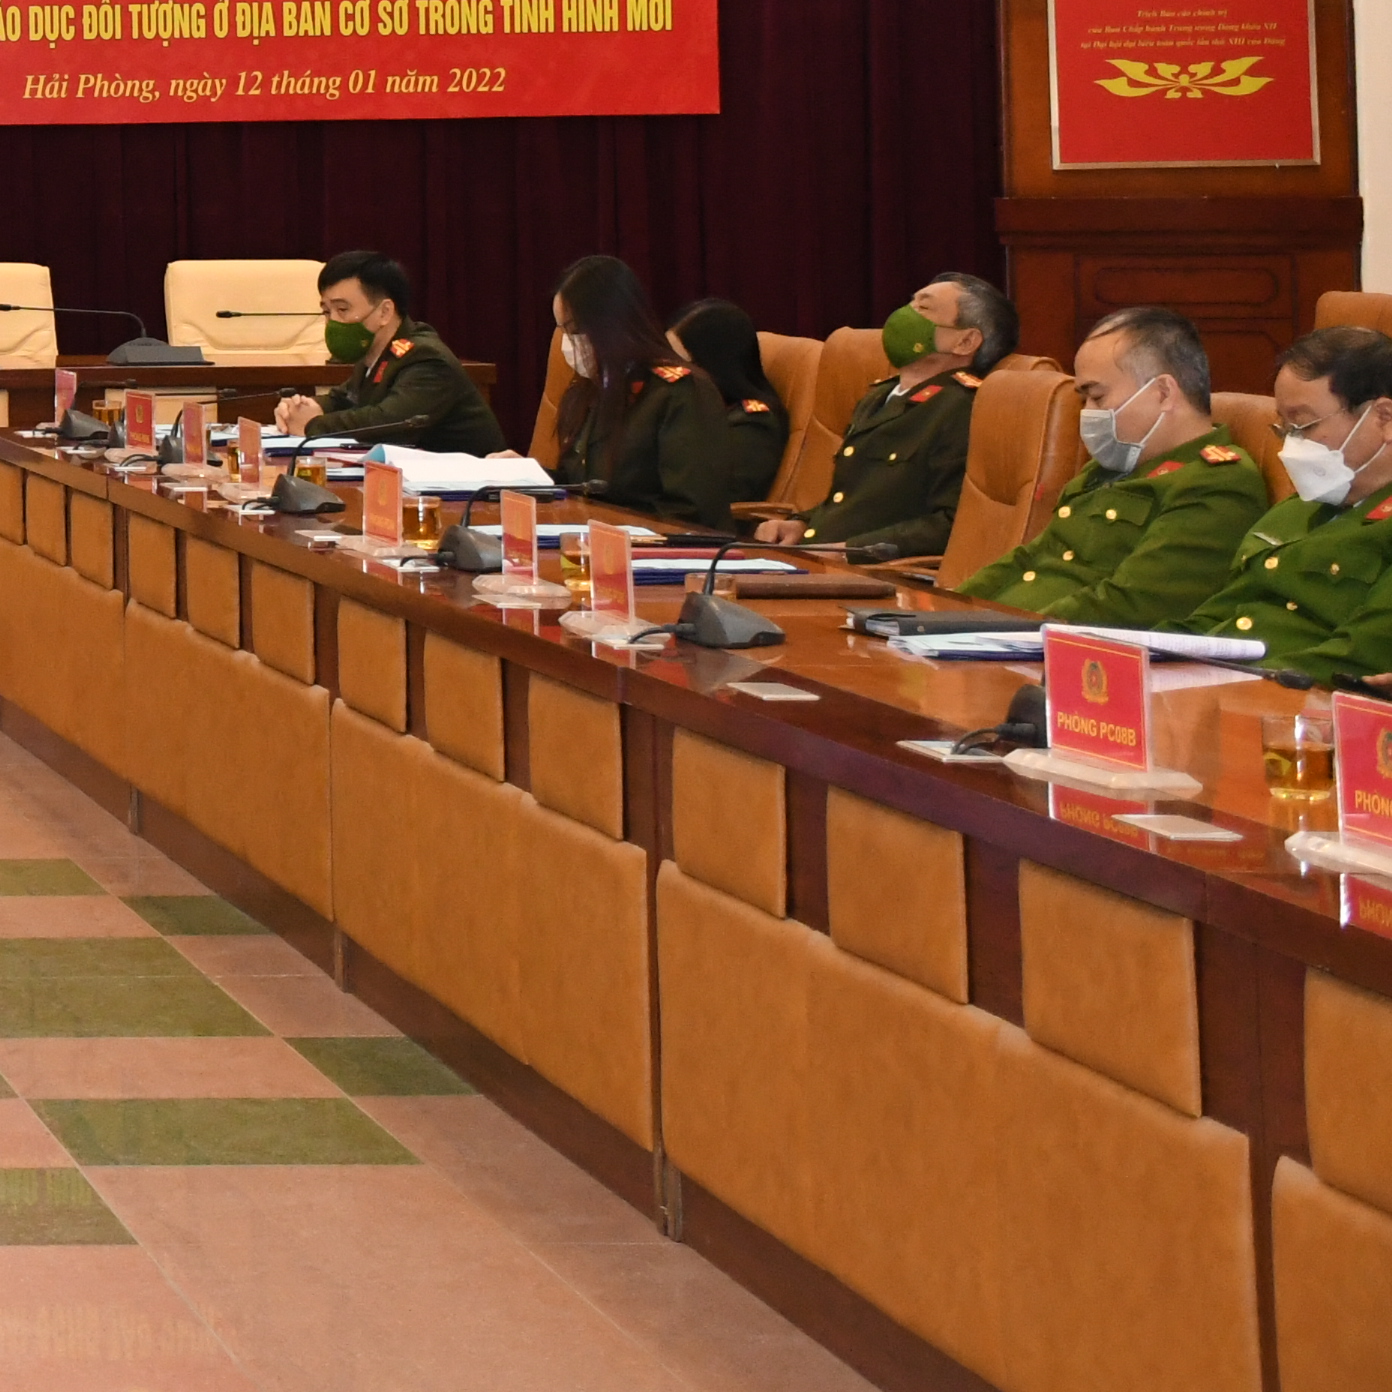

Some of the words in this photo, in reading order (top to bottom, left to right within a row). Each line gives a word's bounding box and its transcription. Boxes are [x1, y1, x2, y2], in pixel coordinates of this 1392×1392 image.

[29, 5, 75, 48] DỤC
[129, 0, 205, 46] TƯỢNG
[236, 2, 275, 45] ĐỊA
[416, 0, 493, 34] TRONG
[23, 74, 68, 98] Hải
[76, 74, 159, 102] Phòng,
[170, 72, 226, 102] ngày
[236, 71, 262, 95] 12
[271, 70, 341, 99] tháng
[349, 70, 375, 93] 01
[386, 70, 438, 92] năm
[447, 68, 505, 92] 2022
[1057, 711, 1097, 737] PHÒNG
[1099, 722, 1137, 747] PC08B
[1354, 789, 1392, 818] PHÒN
